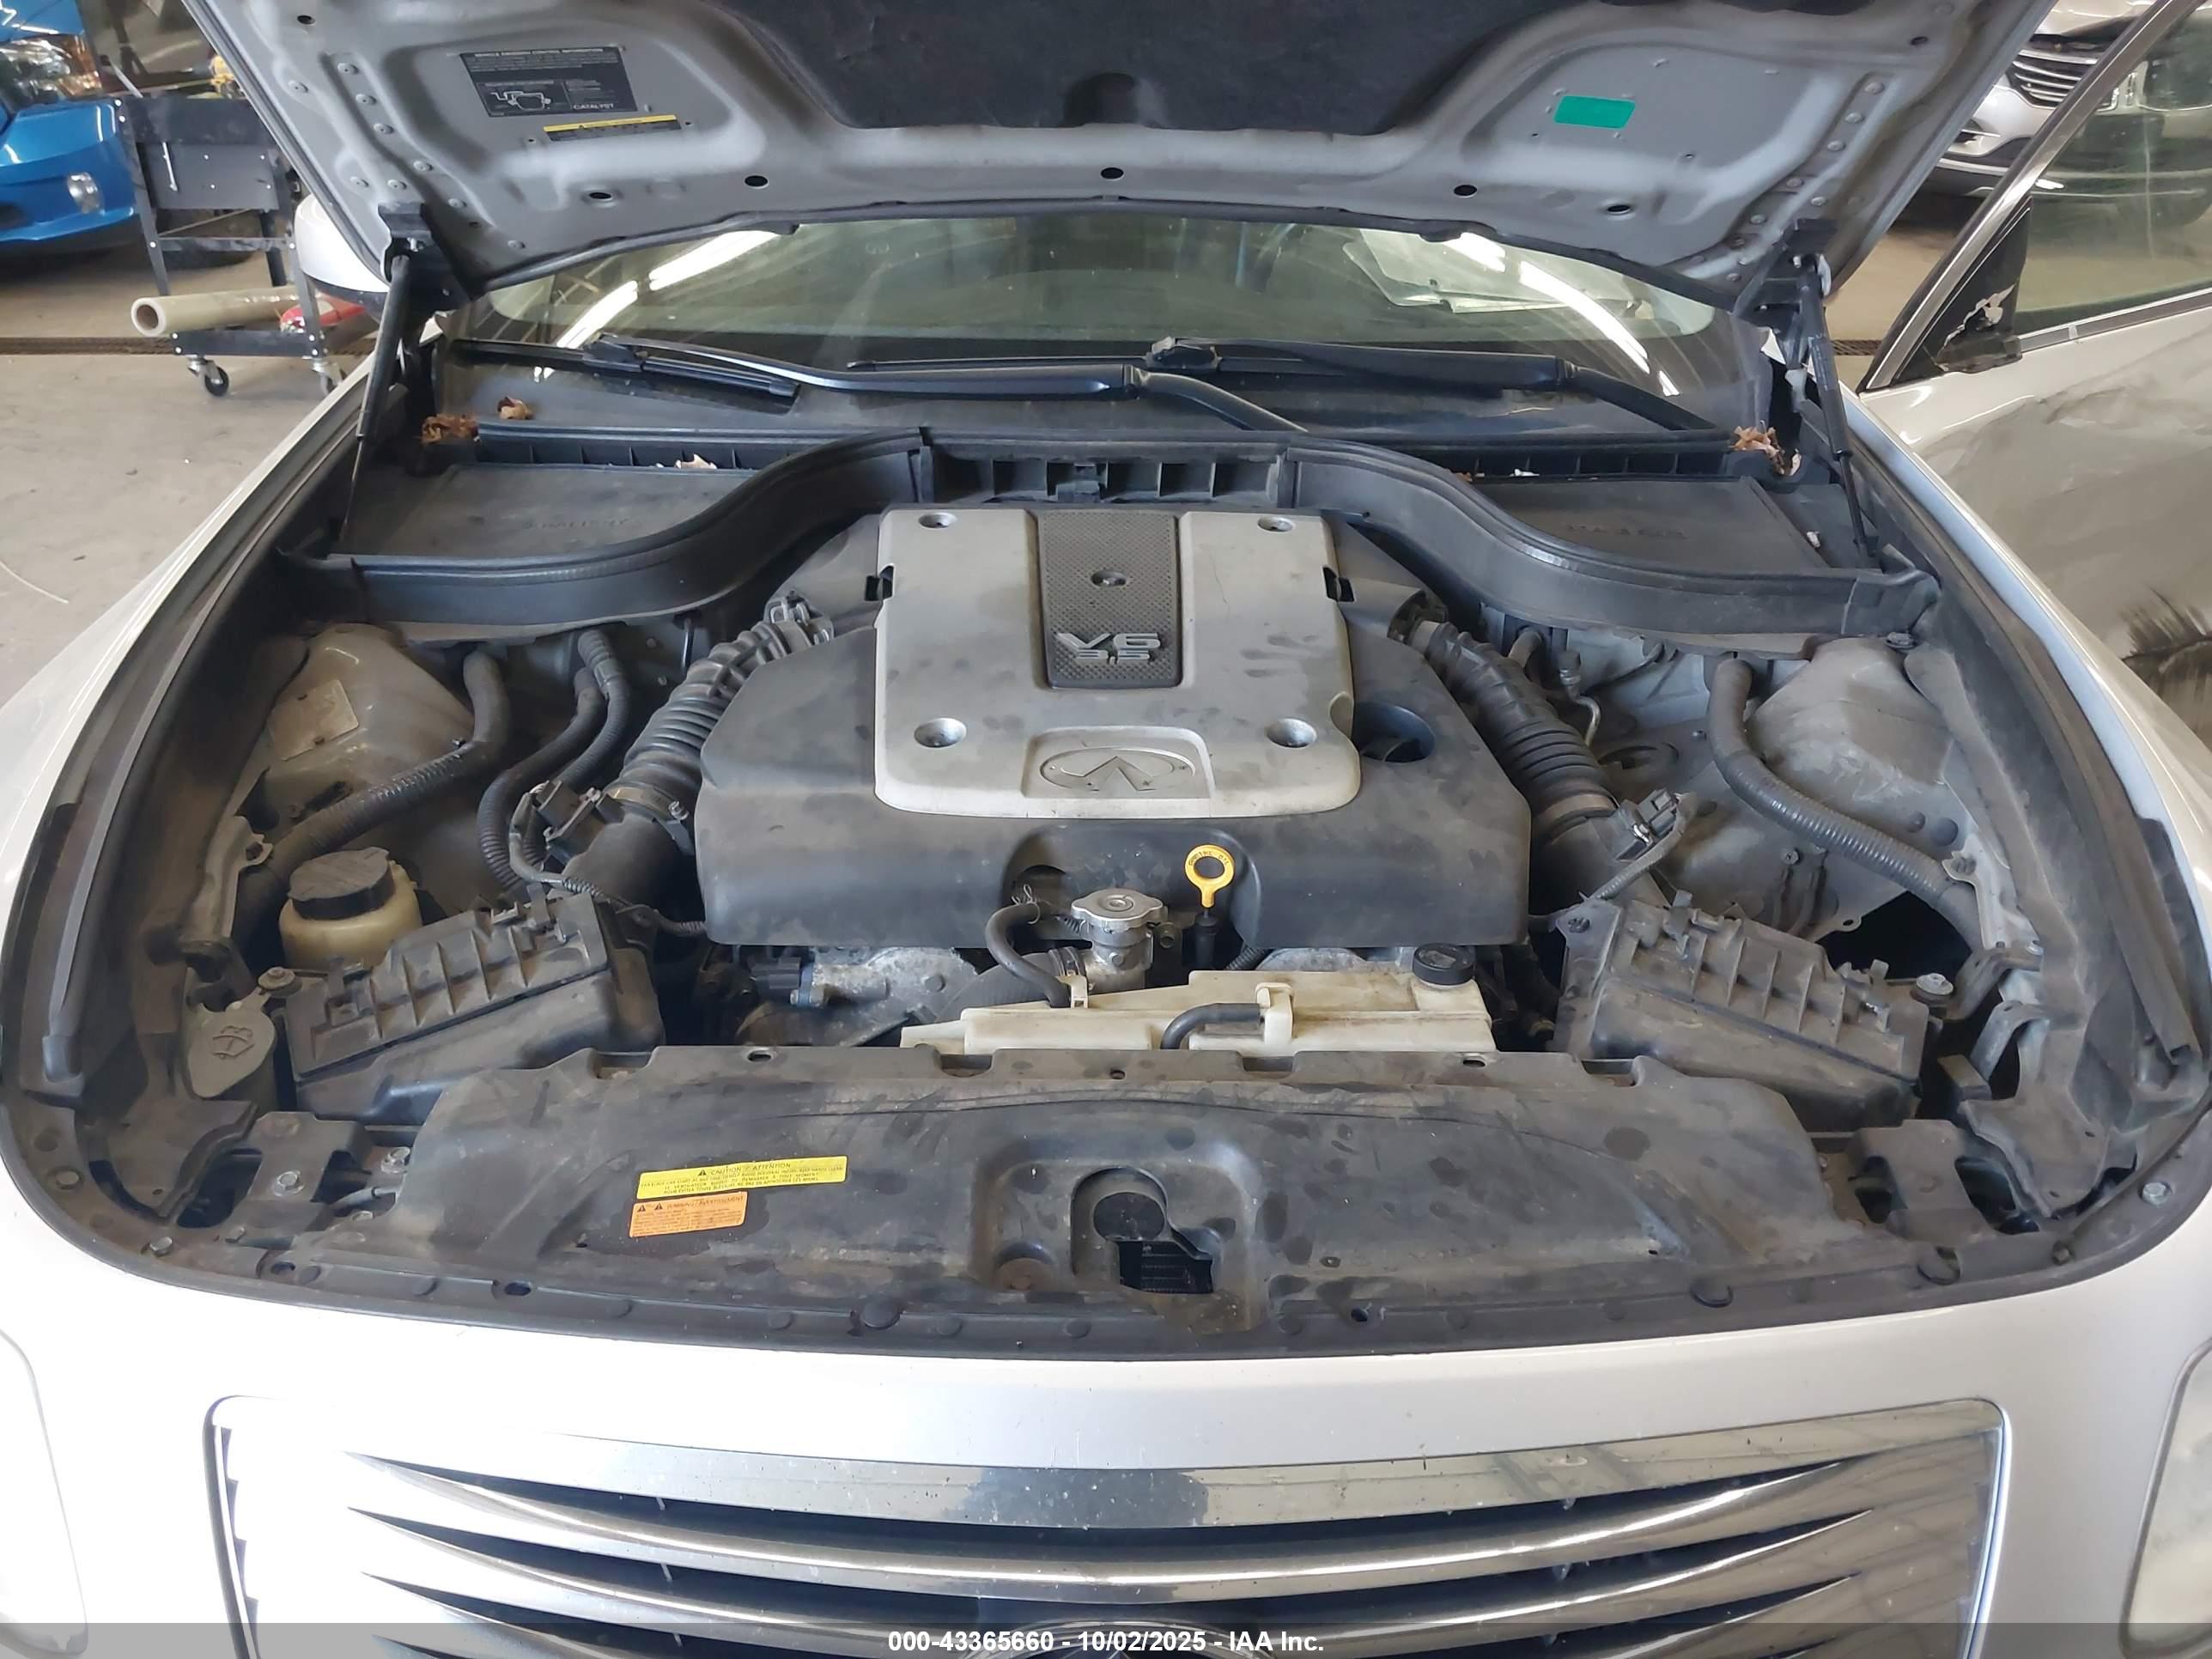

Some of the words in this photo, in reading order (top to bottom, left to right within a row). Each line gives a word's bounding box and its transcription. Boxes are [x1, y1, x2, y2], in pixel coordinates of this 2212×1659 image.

[1057, 632, 1161, 649] V6
[1075, 650, 1151, 664] 3.5
[710, 1167, 742, 1176] CAUTION
